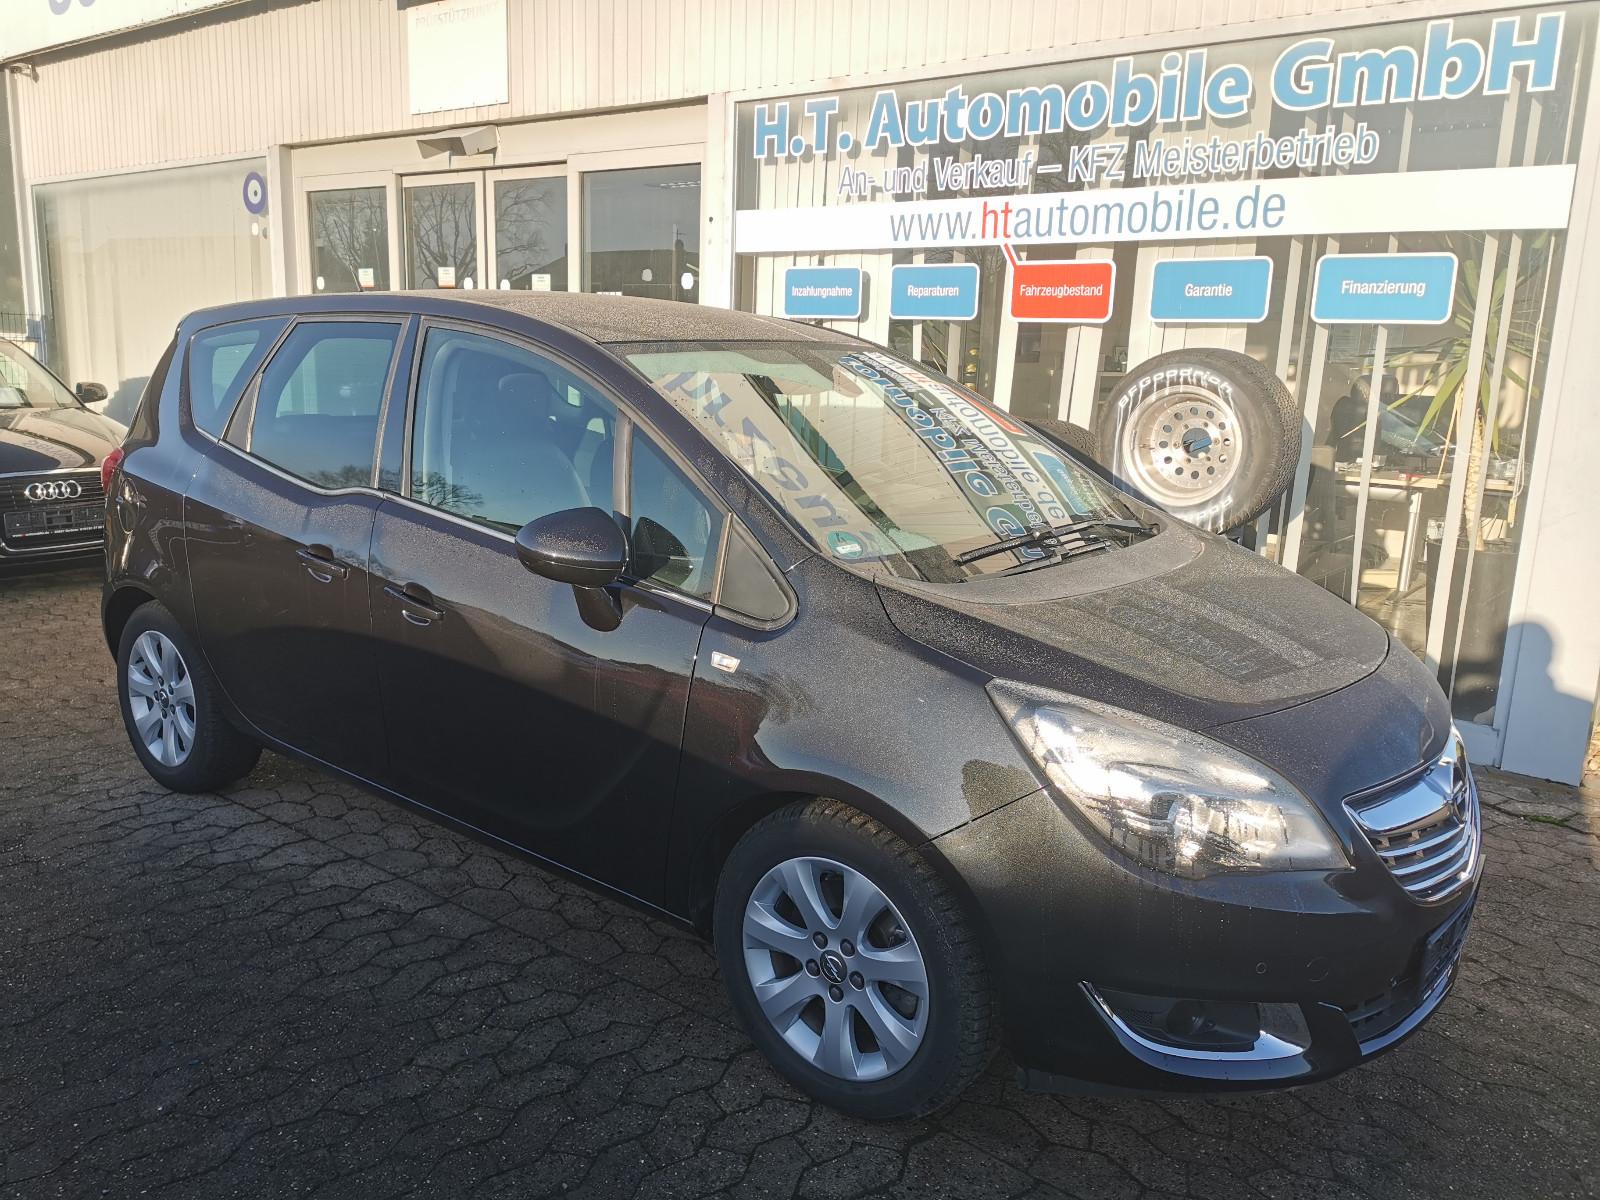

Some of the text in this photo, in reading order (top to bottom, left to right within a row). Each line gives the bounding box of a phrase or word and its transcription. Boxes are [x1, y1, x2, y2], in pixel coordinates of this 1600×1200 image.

[754, 11, 1567, 159] H.T. Automobile GmbH
[838, 166, 876, 197] An-
[882, 160, 928, 194] und
[933, 151, 1033, 191] Verkauf
[1068, 143, 1127, 182] KFZ
[1133, 122, 1380, 179] Meisterbetrieb
[890, 184, 1287, 243] www.htautomobile.de
[791, 284, 853, 298] Inzahlungnahme
[907, 284, 959, 298] Reparaturen
[1019, 282, 1103, 299] Fahrzeugbestand
[1184, 283, 1233, 298] Garantie
[1341, 279, 1427, 297] Finanzierung
